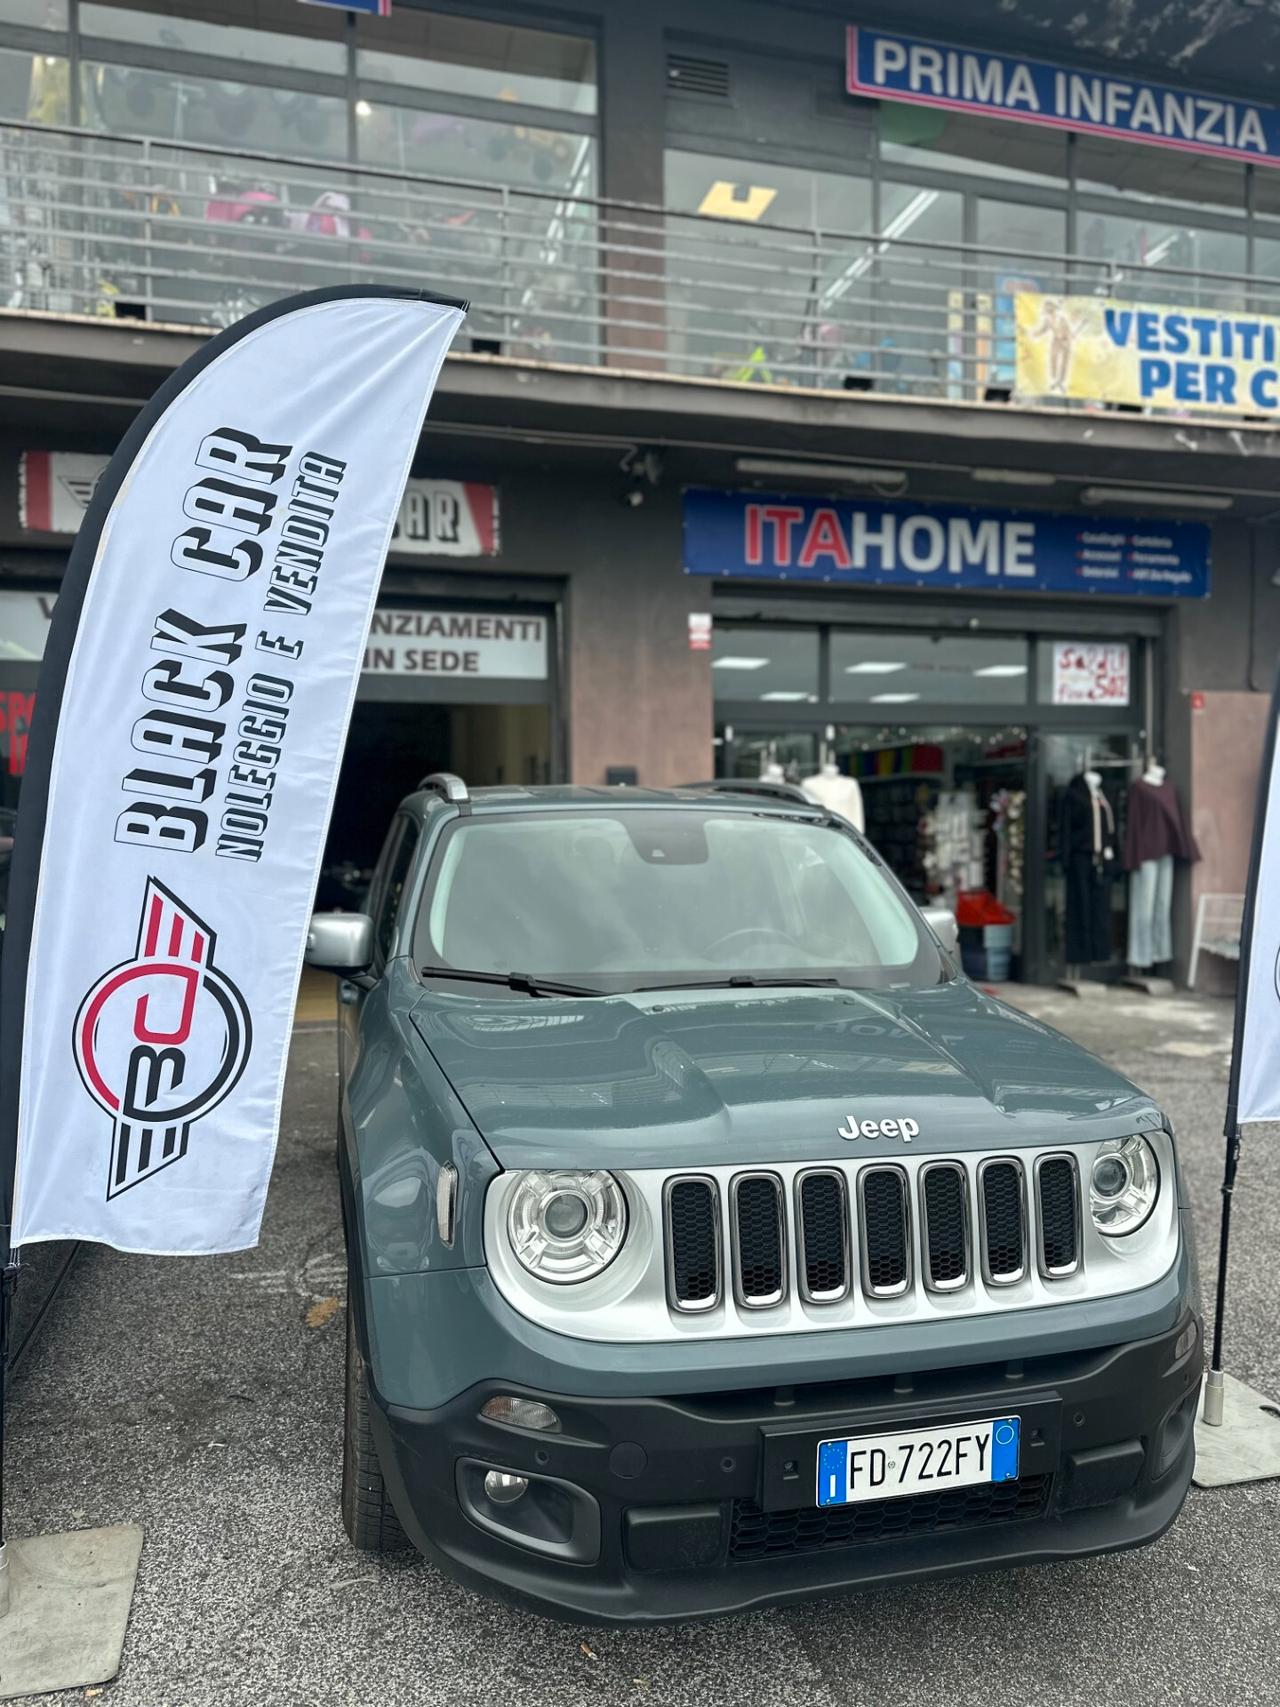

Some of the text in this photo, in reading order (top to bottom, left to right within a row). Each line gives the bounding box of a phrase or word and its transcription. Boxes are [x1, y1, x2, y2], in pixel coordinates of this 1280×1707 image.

[872, 39, 1267, 153] PRIMA INFANZIA
[1104, 309, 1275, 362] VESTITI
[1140, 358, 1237, 405] PER
[392, 488, 461, 543] AR
[745, 504, 1036, 577] ITAHOME
[114, 427, 293, 853] BLACK CAR
[215, 451, 347, 863] NOLEGGIO E VENDITA
[361, 647, 480, 672] IN SEDE
[837, 1115, 920, 1143] Jeep
